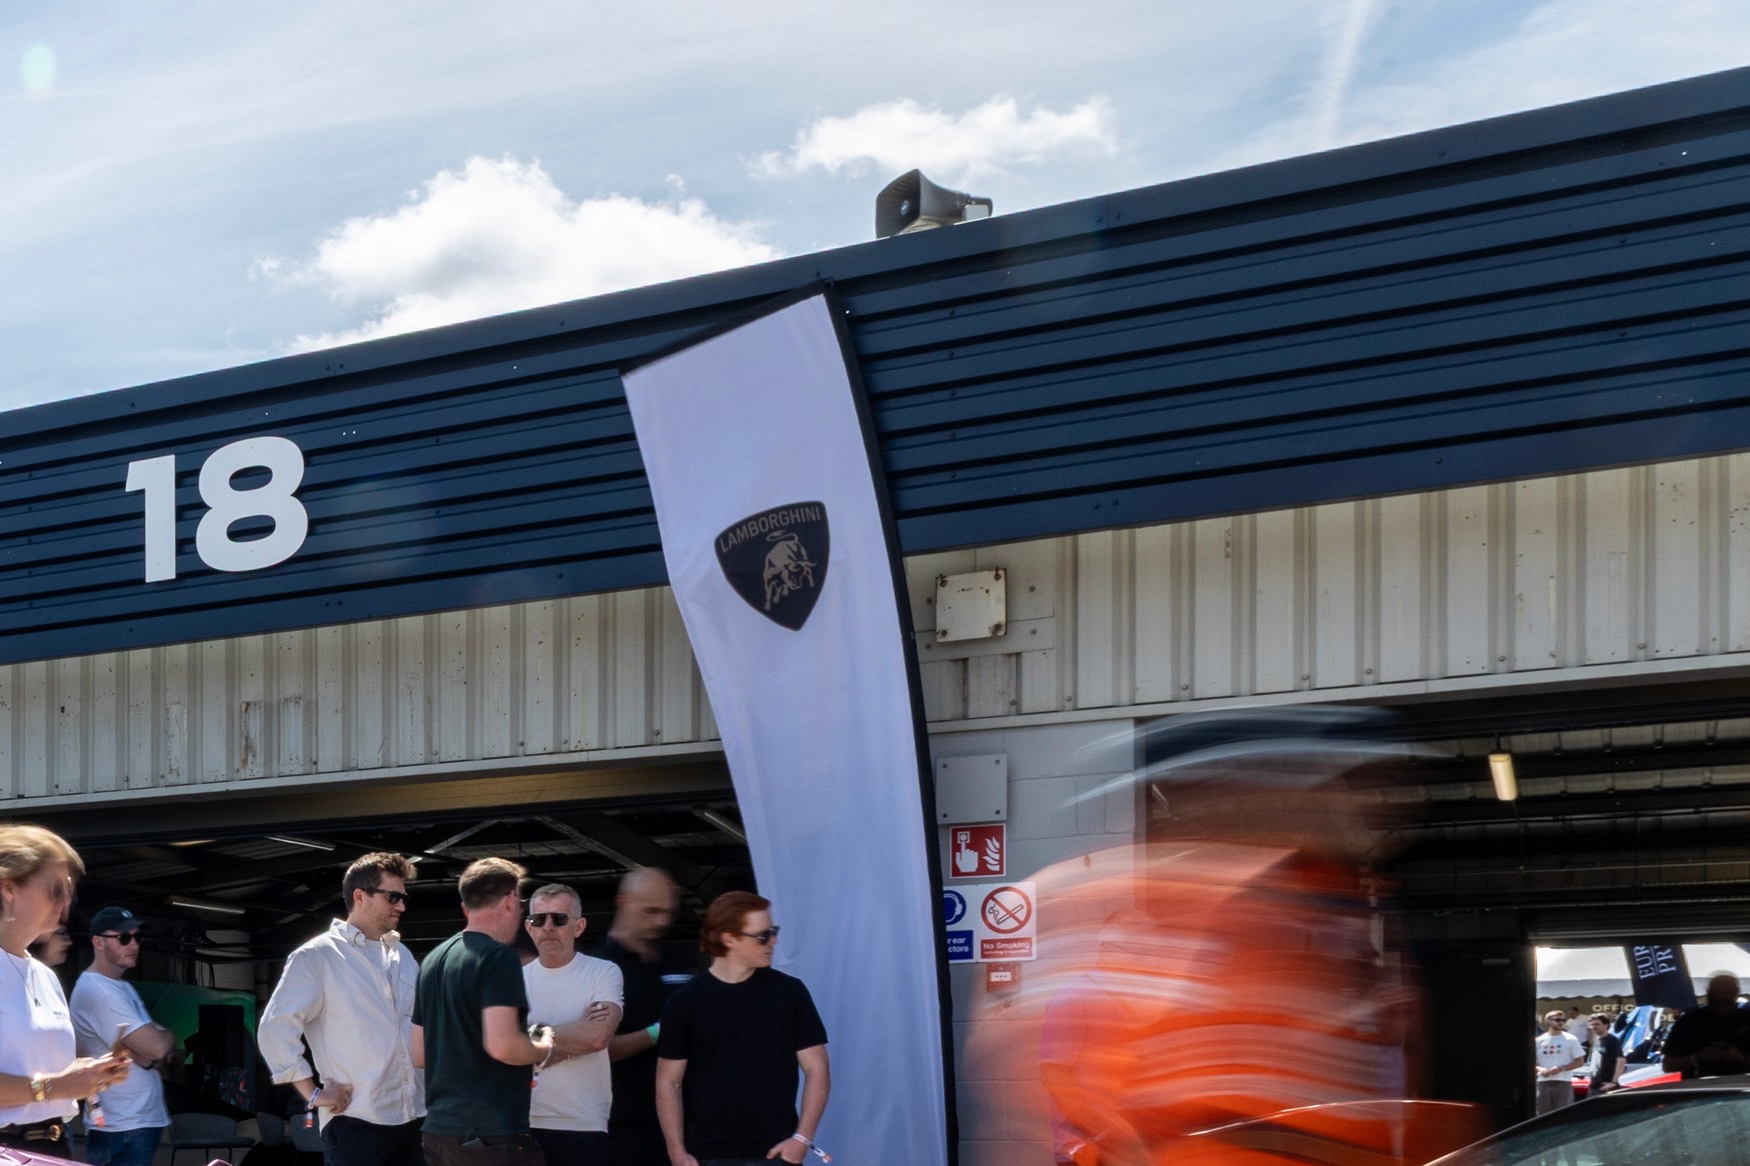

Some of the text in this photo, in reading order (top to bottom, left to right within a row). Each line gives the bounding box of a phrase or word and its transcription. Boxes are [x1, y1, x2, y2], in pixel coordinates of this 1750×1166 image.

[125, 436, 308, 583] 18
[720, 506, 821, 553] LAMBORGHINI
[996, 942, 1030, 950] Smoking
